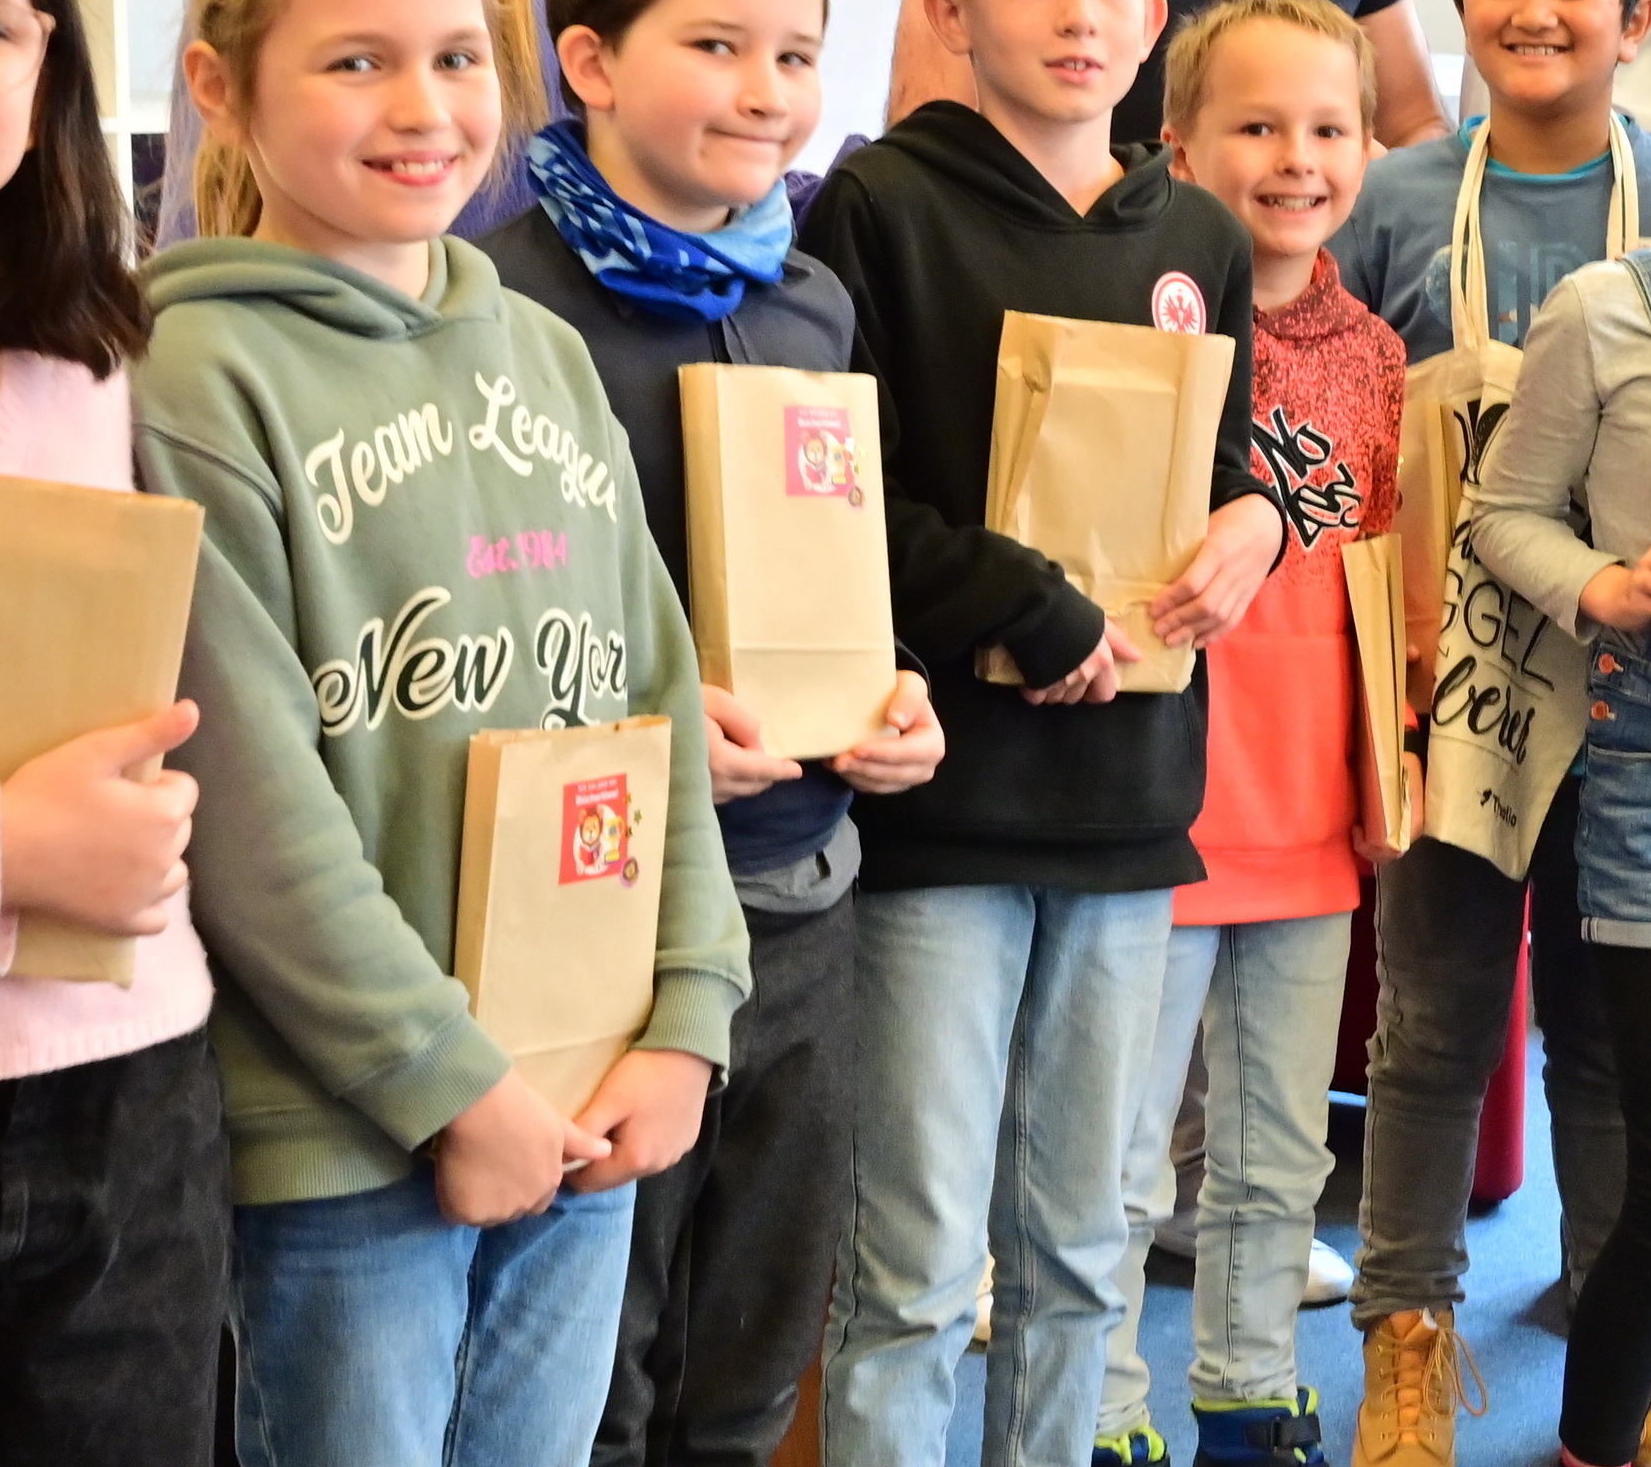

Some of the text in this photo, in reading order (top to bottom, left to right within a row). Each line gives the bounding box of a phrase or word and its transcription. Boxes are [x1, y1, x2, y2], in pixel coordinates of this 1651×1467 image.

[305, 370, 617, 546] Team Leagu
[313, 585, 628, 736] New Yor
